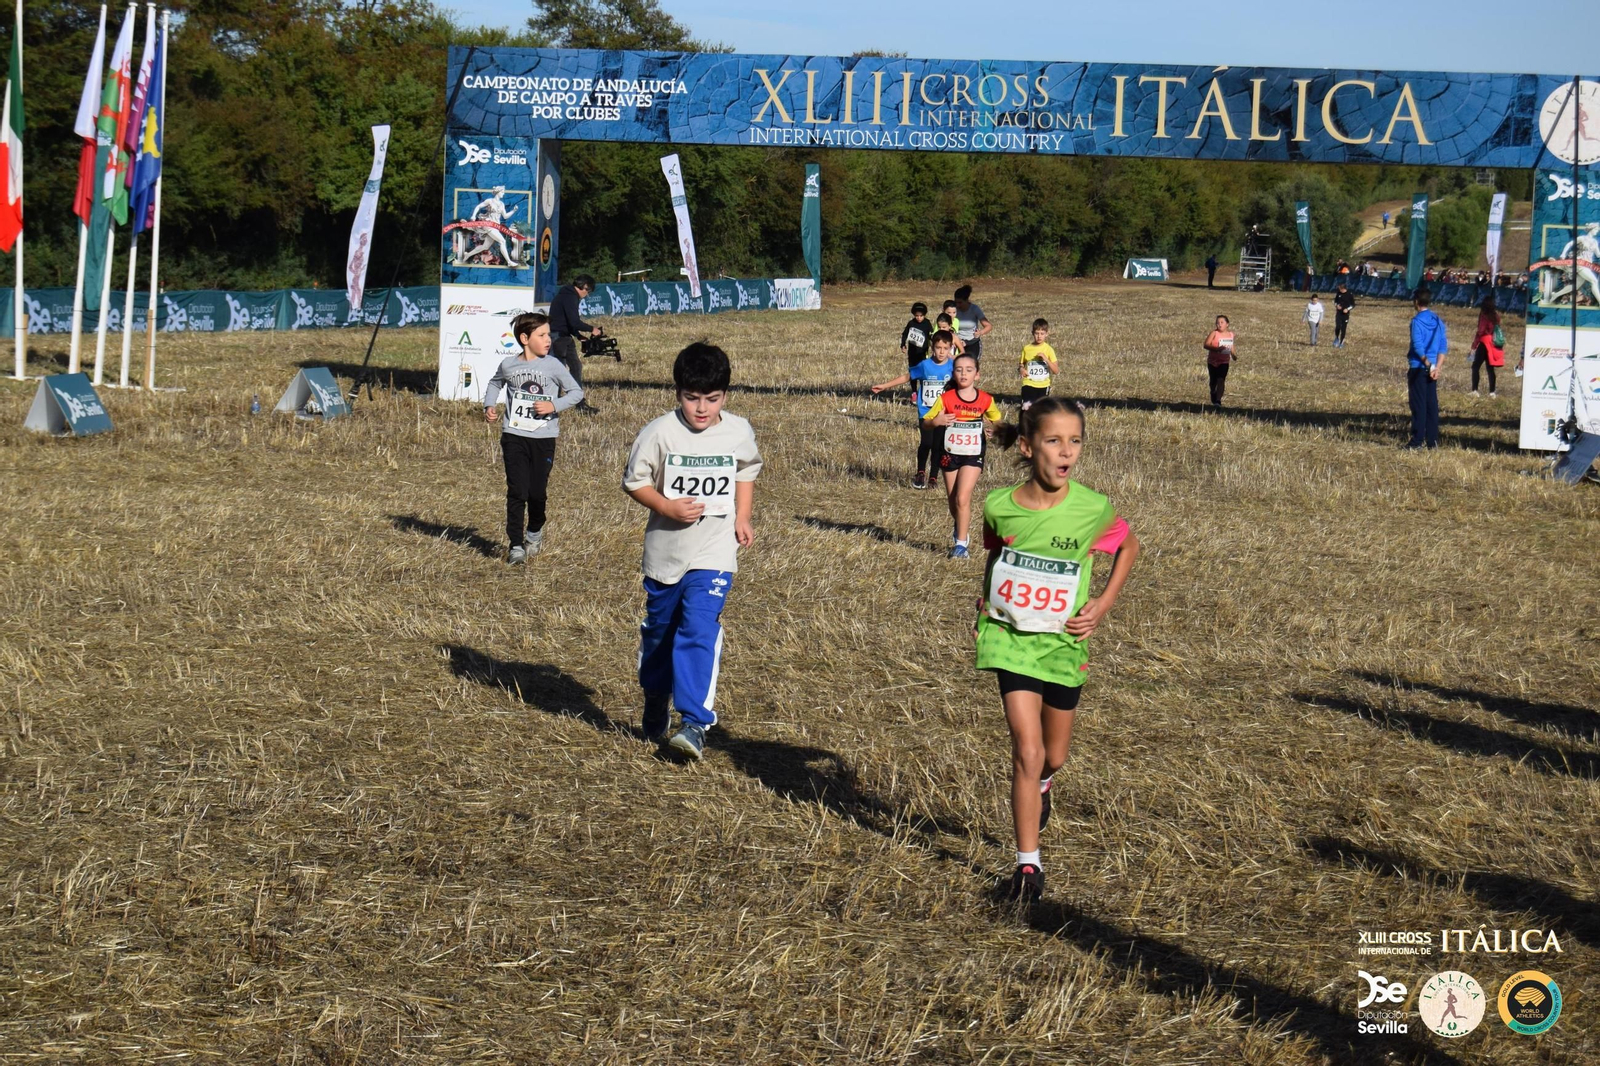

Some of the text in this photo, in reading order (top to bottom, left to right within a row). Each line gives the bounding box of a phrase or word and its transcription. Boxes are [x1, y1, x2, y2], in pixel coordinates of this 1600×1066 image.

[463, 75, 688, 94] CAMPEONATO DE ANDALUCÍA
[498, 90, 652, 107] DE CAMPO A TRAVÉS
[750, 69, 1050, 126] XLIII CROSS
[1109, 66, 1434, 146] ITÁLICA
[533, 105, 620, 121] POR CLUBES
[919, 109, 1097, 130] INTERNACIONAL
[750, 127, 1064, 150] INTERNATIONAL CROSS COUNTRY
[494, 147, 527, 155] Diputación
[493, 155, 527, 165] Sevilla
[189, 315, 214, 331] Sevilla
[948, 433, 979, 446] 4531
[671, 475, 730, 497] 4202
[1051, 536, 1079, 550] SJA
[1019, 556, 1059, 572] ITÁLICA
[997, 579, 1069, 613] 4395
